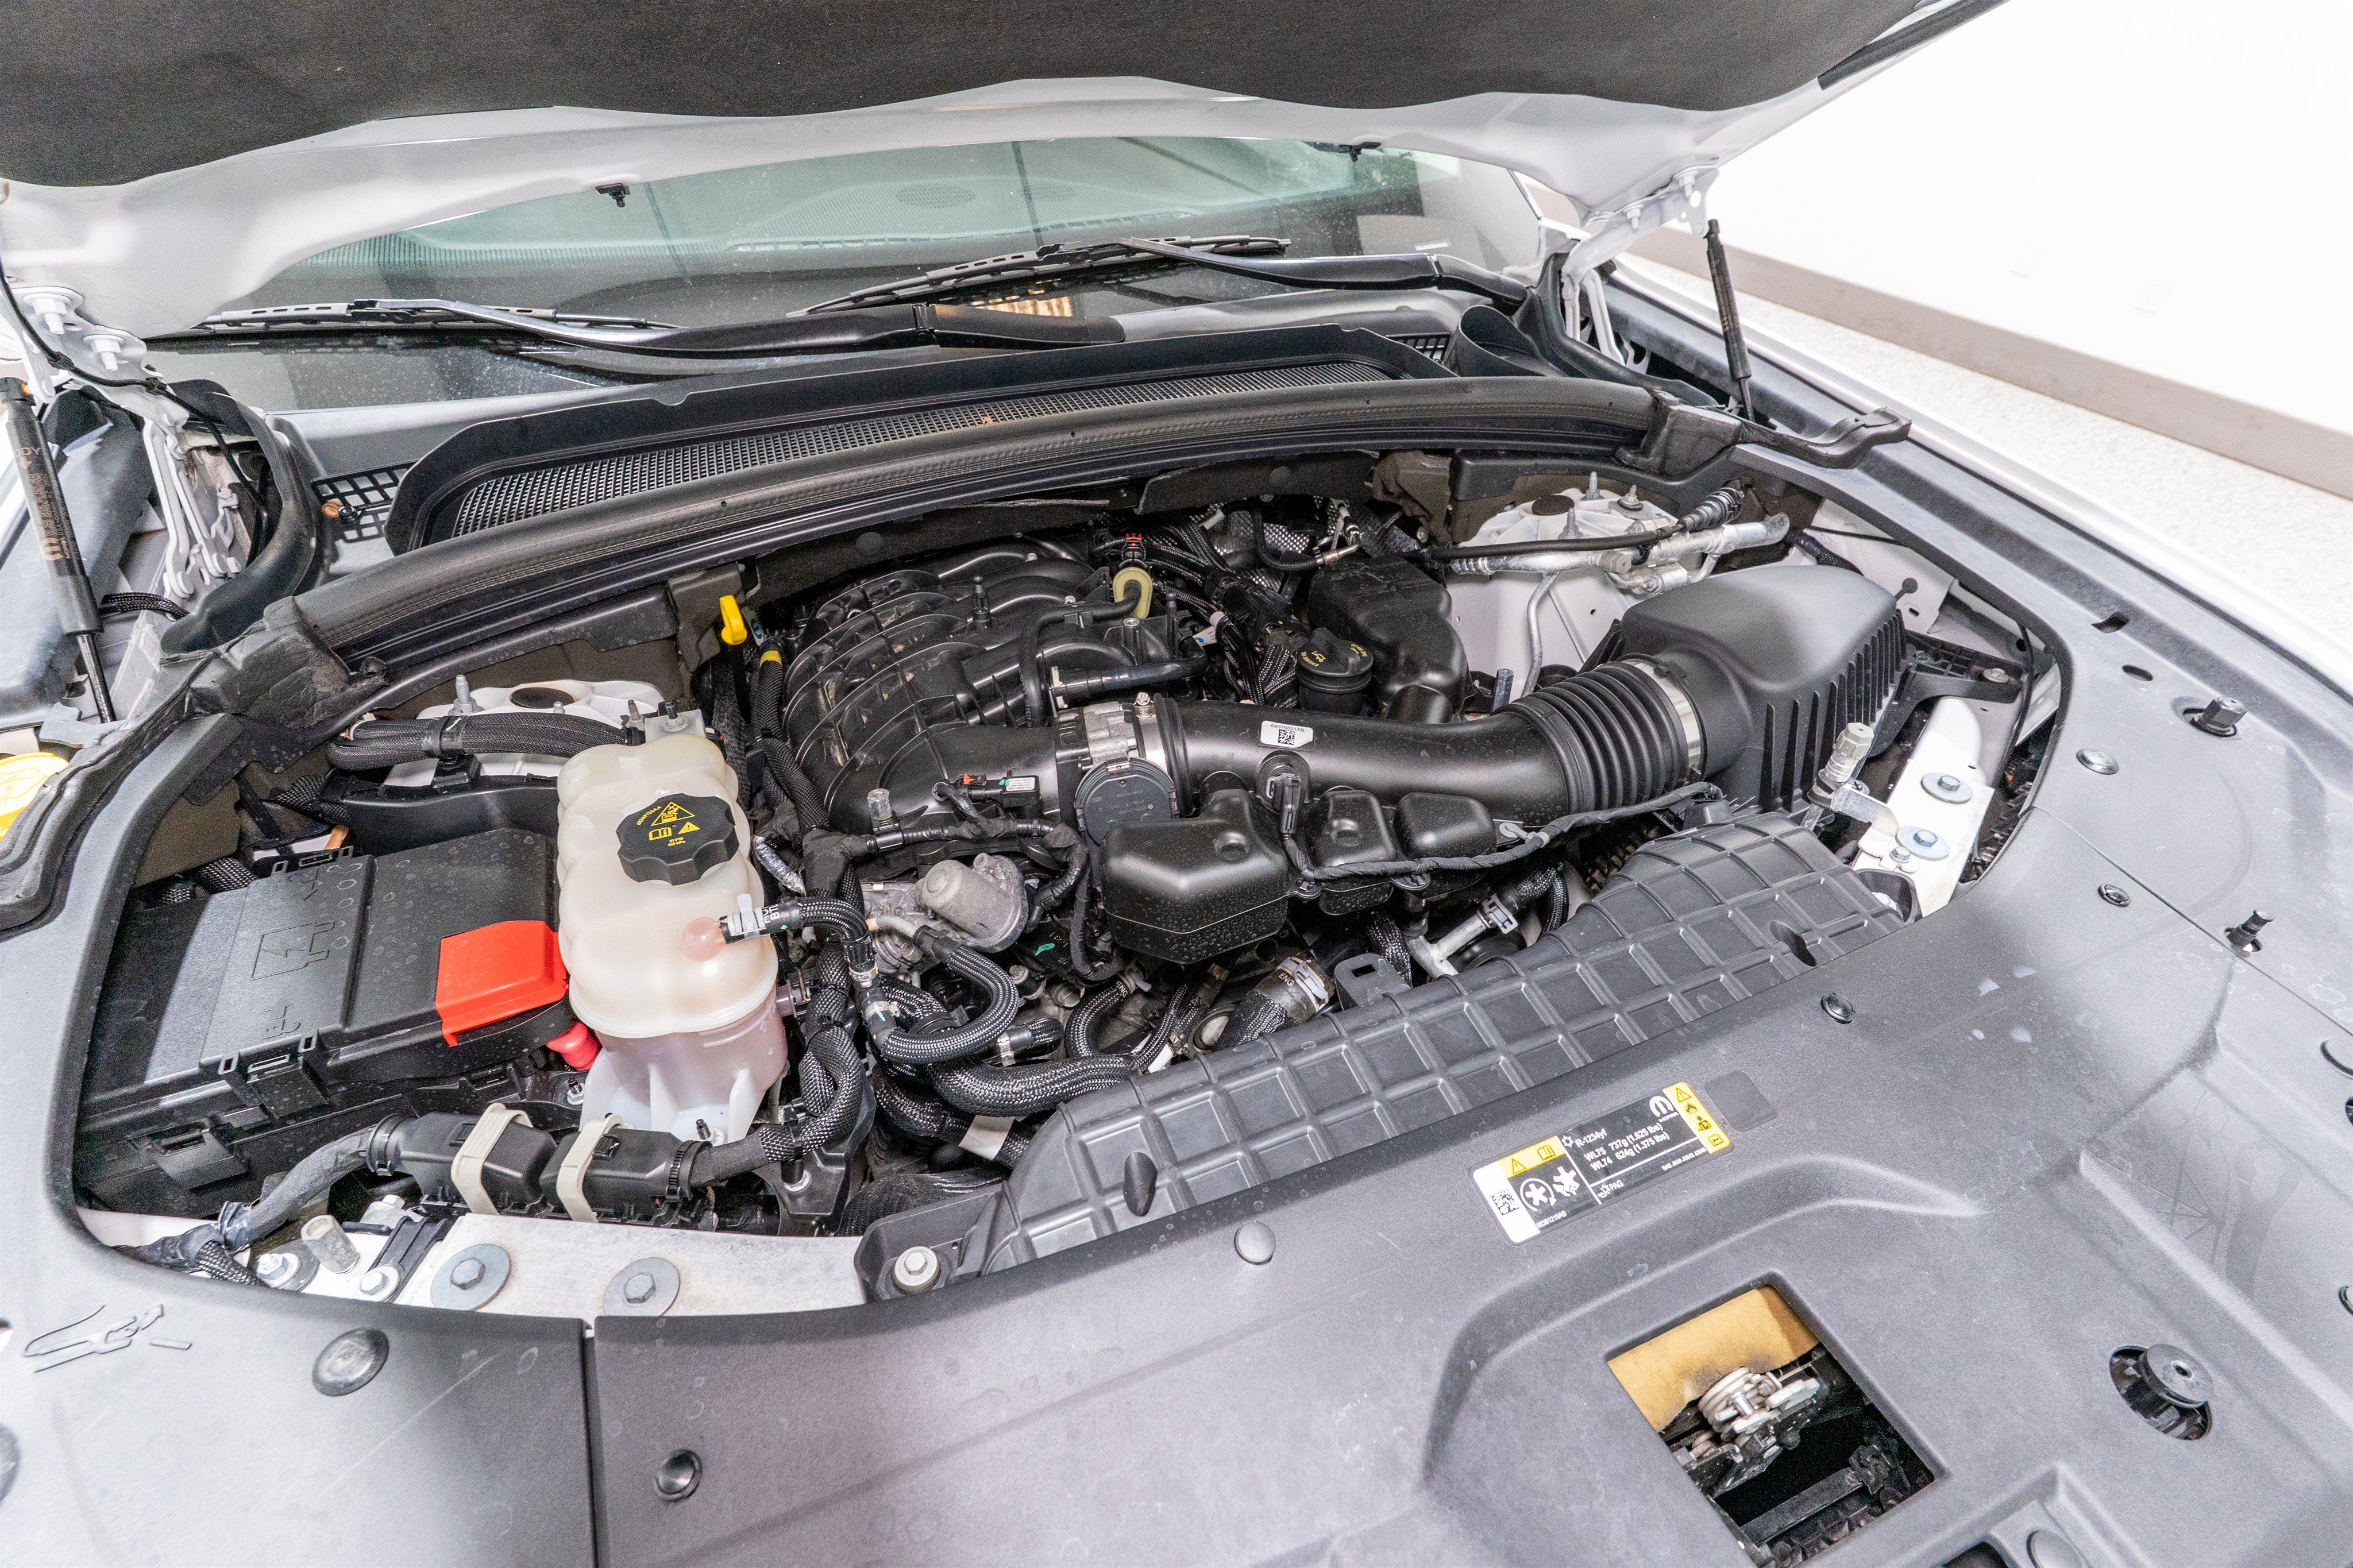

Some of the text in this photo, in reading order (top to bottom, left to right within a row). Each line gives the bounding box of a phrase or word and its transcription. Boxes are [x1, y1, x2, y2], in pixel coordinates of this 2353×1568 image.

[1271, 724, 1305, 732] 68376821AB
[1278, 972, 1294, 986] ENG
[1116, 980, 1128, 998] ENG
[1575, 1128, 1607, 1148] R-1234yf
[1584, 1122, 1663, 1161] WL75 737g (1.625 lbs)
[1590, 1131, 1670, 1171] WL74 624g (1.375 lbs)
[1661, 1163, 1672, 1171] SAE
[1610, 1180, 1624, 1191] PAG
